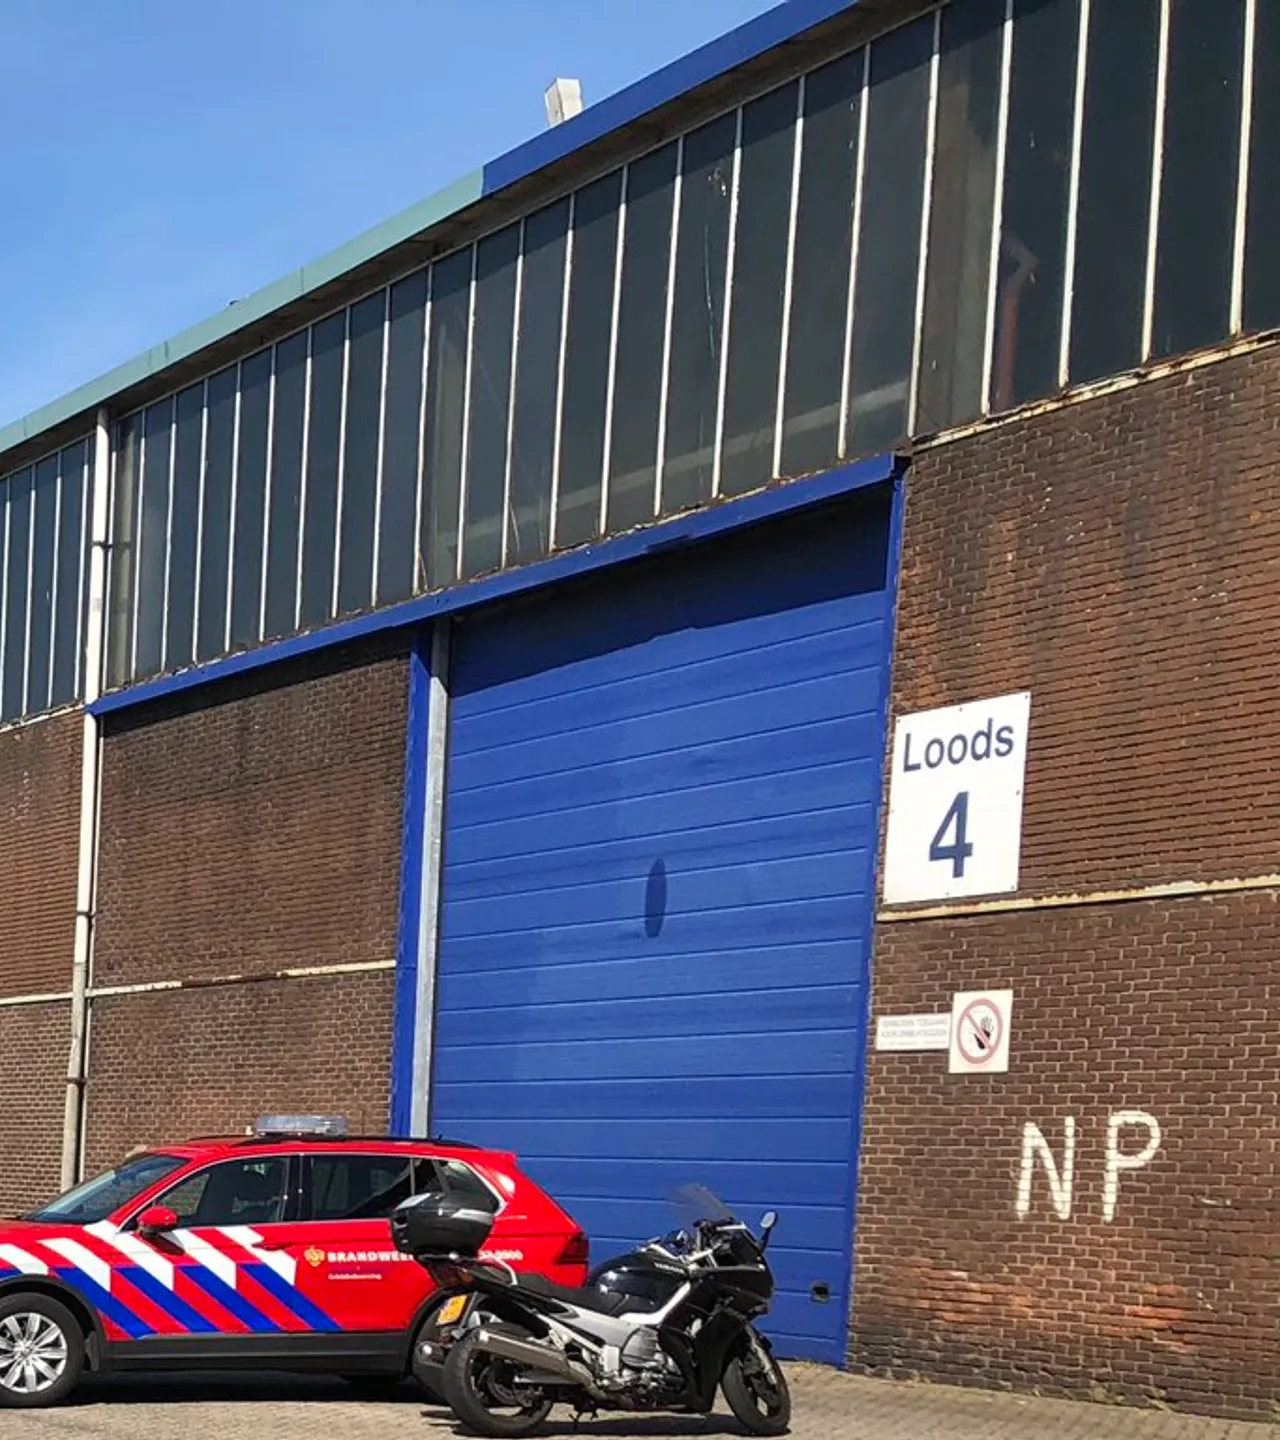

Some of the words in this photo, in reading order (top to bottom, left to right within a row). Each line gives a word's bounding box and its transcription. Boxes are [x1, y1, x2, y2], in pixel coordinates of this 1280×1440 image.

[903, 717, 1014, 773] Loods
[928, 791, 973, 878] 4
[327, 1250, 414, 1263] BRANDWEE
